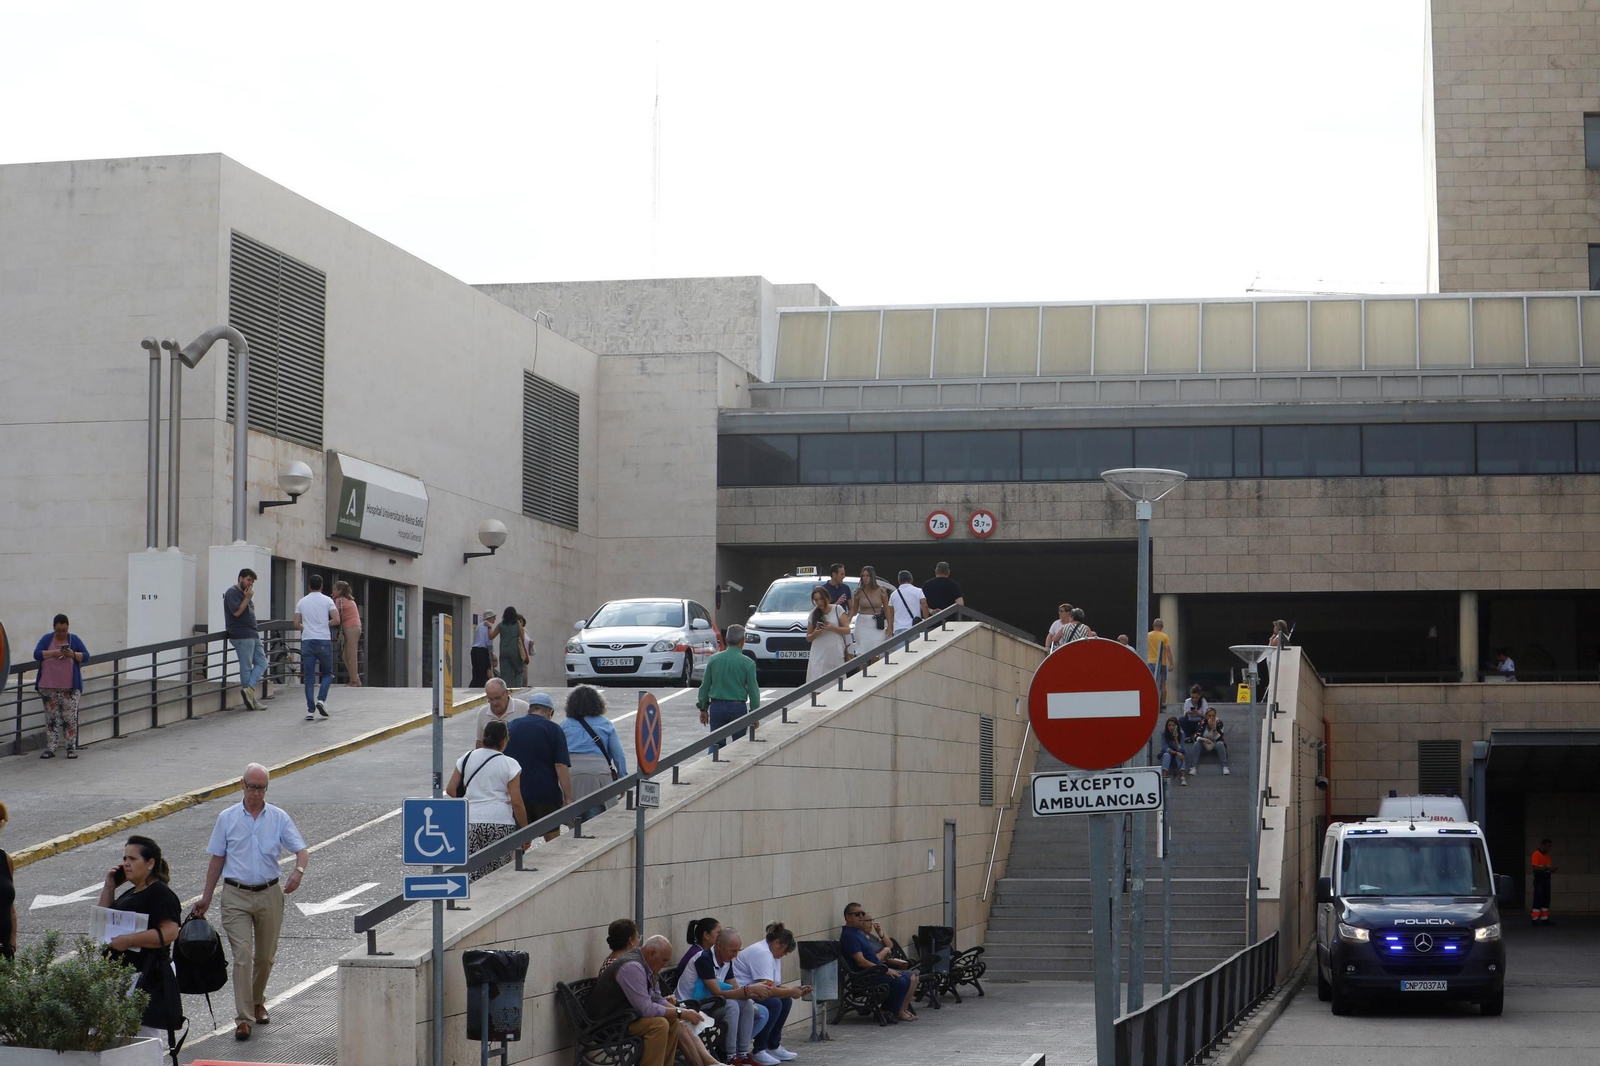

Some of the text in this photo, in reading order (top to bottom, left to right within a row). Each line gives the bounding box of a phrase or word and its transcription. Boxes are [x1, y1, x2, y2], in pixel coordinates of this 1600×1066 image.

[367, 504, 382, 517] Hospital
[382, 508, 405, 523] Universitario
[405, 514, 415, 526] Reina
[398, 604, 402, 635] E
[1059, 777, 1135, 792] EXCEPTO
[1039, 793, 1156, 810] AMBULANCIAS
